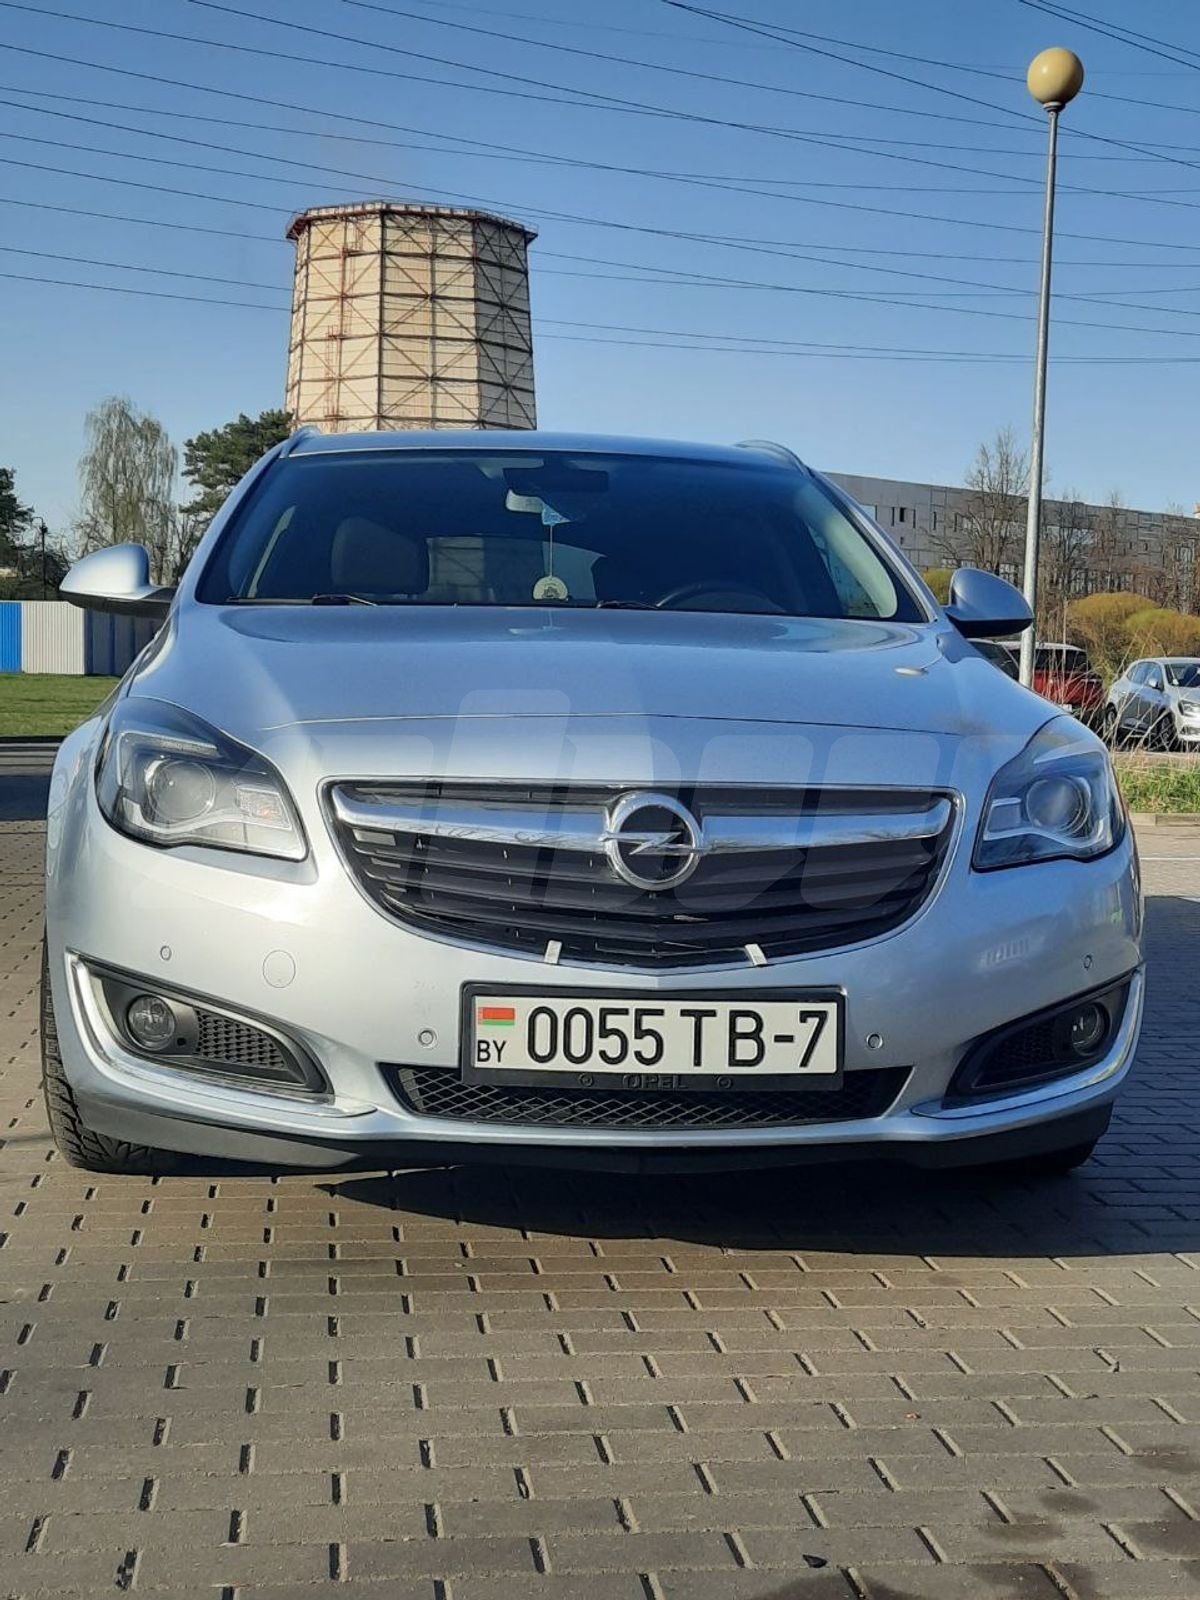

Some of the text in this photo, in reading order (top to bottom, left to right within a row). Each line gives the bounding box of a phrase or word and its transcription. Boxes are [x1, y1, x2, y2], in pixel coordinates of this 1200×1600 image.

[527, 1006, 829, 1068] 0055 TB-7
[476, 1040, 507, 1063] BY
[622, 1074, 689, 1090] OPEL
